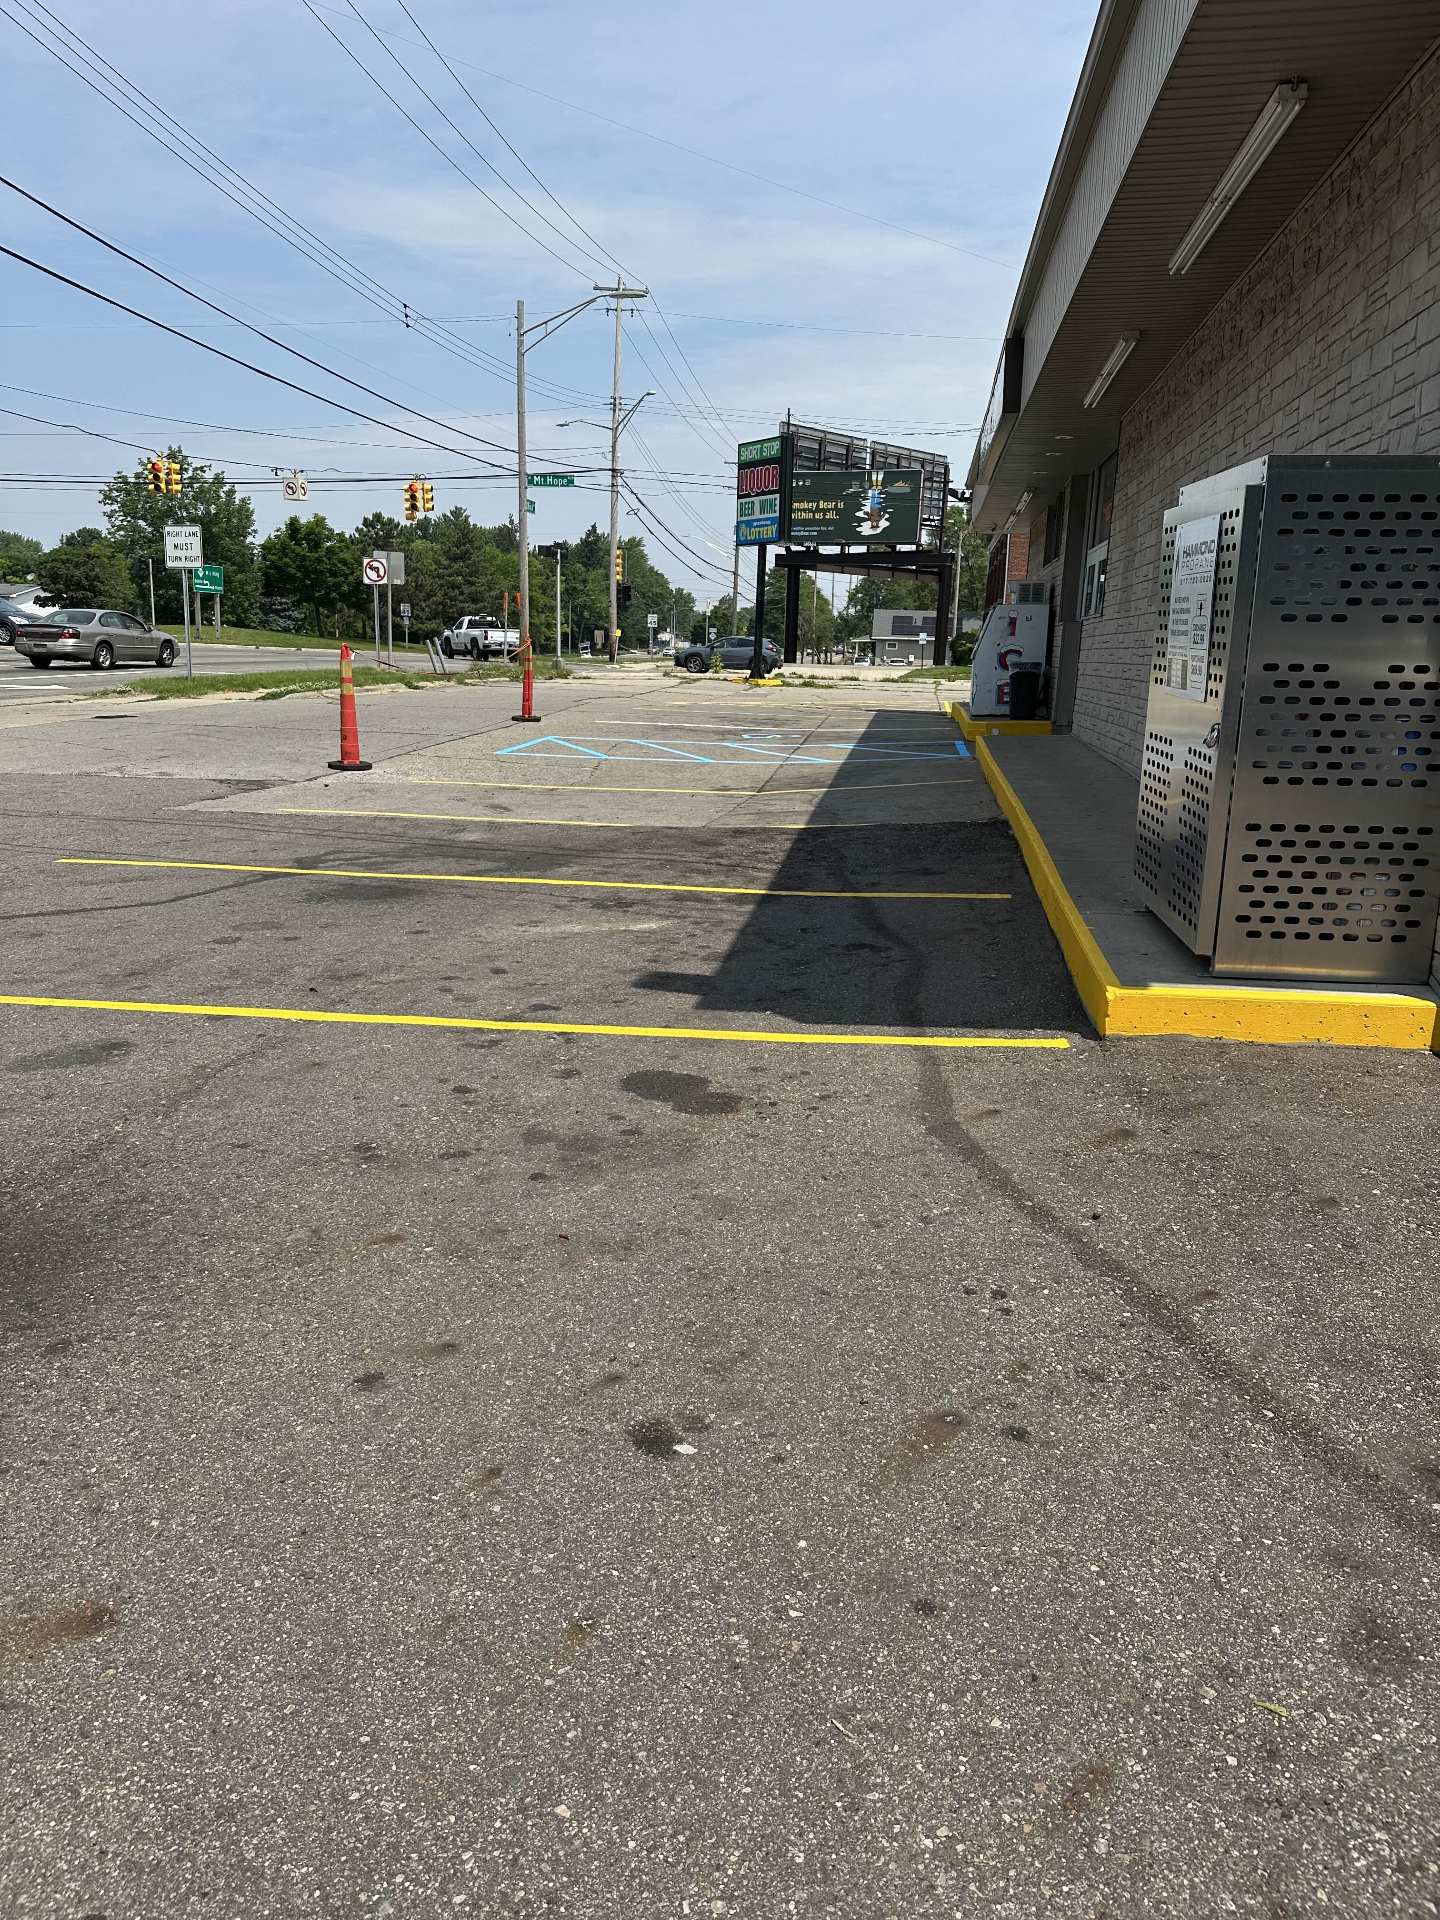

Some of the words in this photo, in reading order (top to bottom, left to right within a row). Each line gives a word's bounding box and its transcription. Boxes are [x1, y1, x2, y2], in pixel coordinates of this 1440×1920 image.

[740, 445, 761, 461] SHORT
[762, 440, 780, 457] STOP
[547, 476, 568, 487] Hope
[739, 465, 779, 495] LIQUOR
[740, 501, 756, 518] BEER
[759, 497, 778, 516] WINE
[819, 500, 836, 509] Bear
[837, 499, 844, 509] is
[825, 511, 840, 519] all.
[746, 524, 778, 540] LOTTERY
[174, 543, 194, 551] MUST
[1182, 539, 1216, 559] HAMMOND
[1181, 556, 1214, 571] PROPANE
